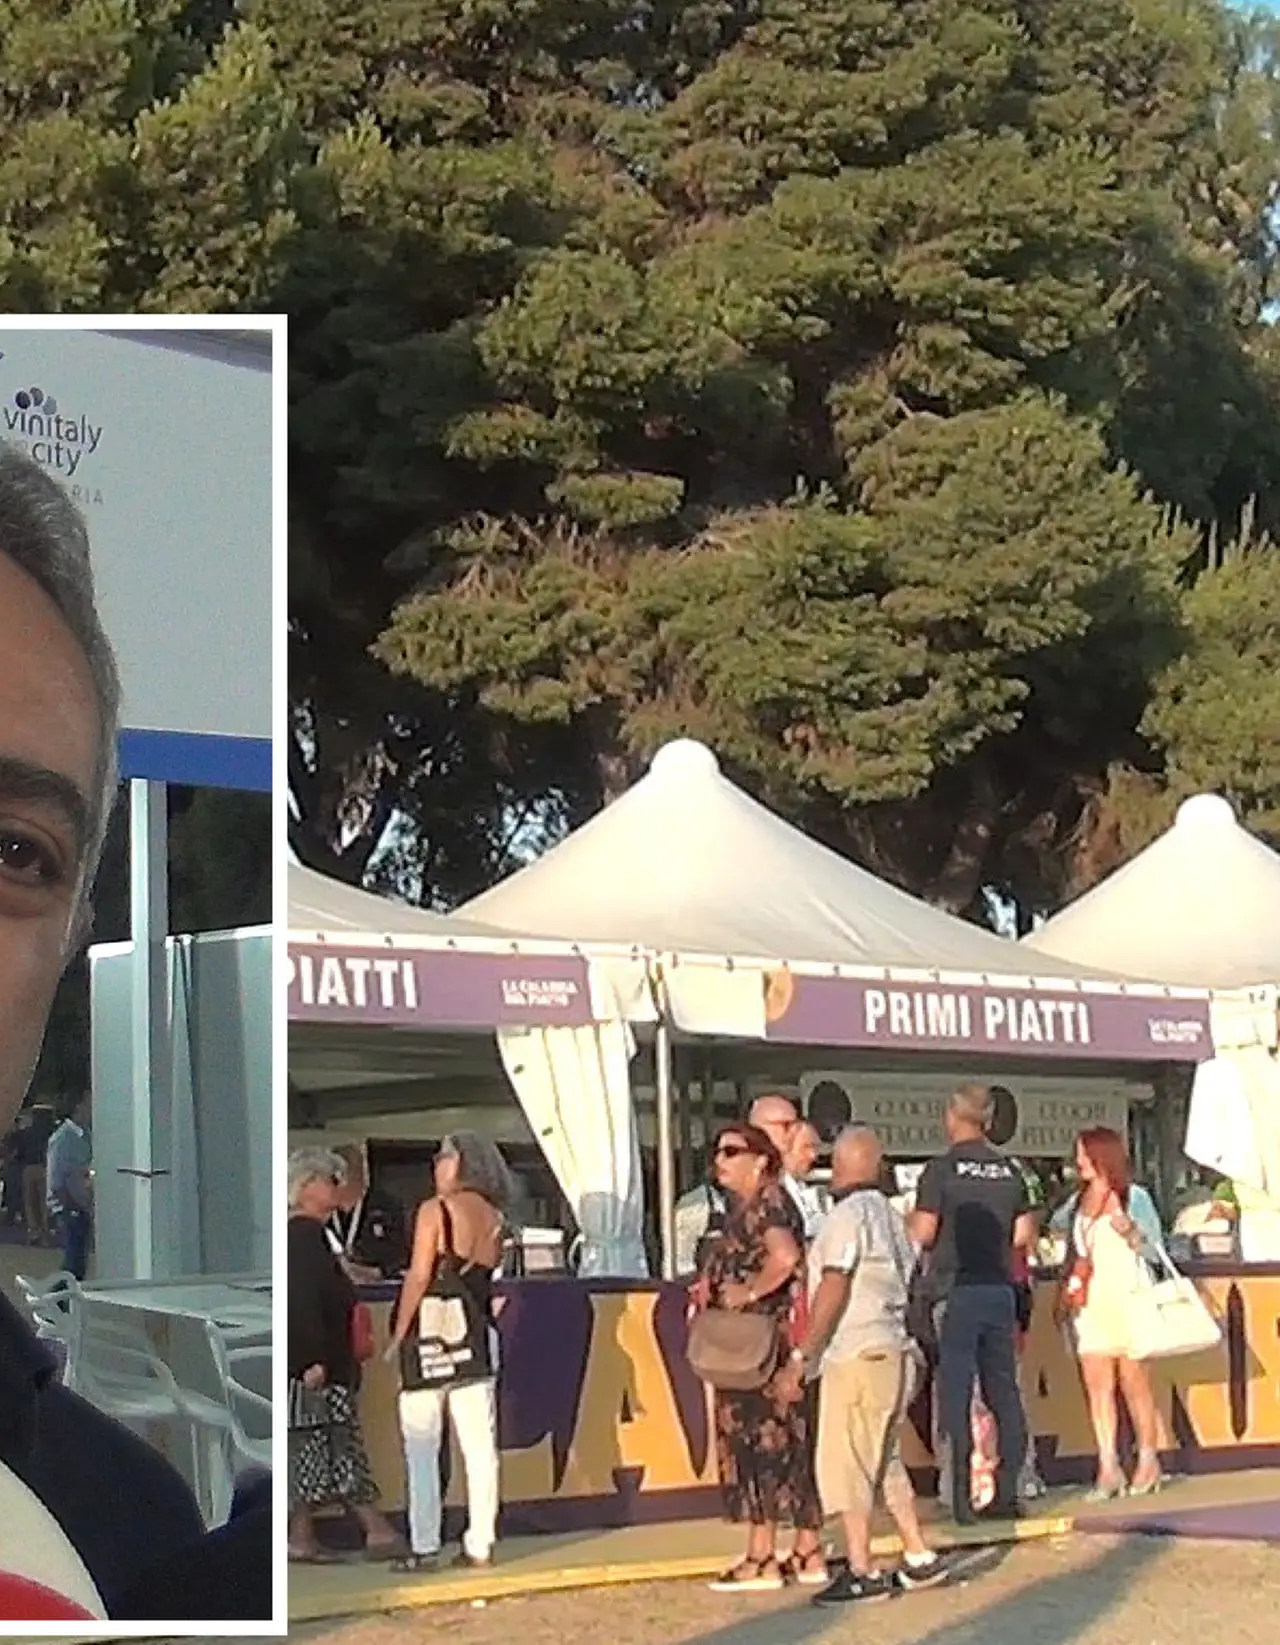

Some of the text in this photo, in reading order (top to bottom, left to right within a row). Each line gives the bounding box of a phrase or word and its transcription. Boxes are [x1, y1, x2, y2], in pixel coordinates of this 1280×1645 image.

[3, 407, 103, 454] vinitaly
[32, 441, 82, 477] city
[864, 989, 971, 1038] PRIMI
[984, 996, 1091, 1044] PIATTI
